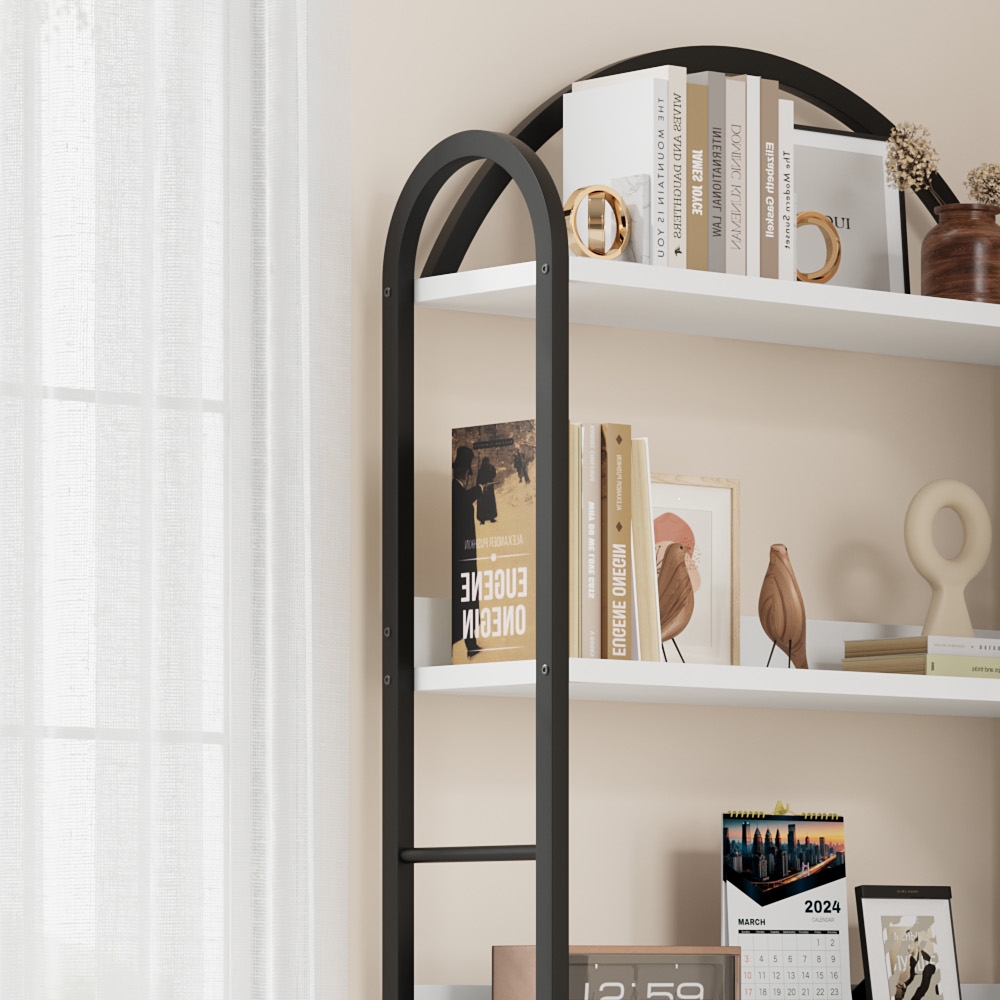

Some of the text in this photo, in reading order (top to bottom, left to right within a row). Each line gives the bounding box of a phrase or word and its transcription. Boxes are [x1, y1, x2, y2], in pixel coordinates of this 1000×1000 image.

[804, 900, 841, 914] 2024
[738, 918, 766, 926] MARCH
[745, 955, 836, 963] 3 4 5 6 7 8 9
[744, 972, 838, 980] 10 11 12 13 14 15 16
[745, 988, 839, 996] 17 18 19 20 21 22 23
